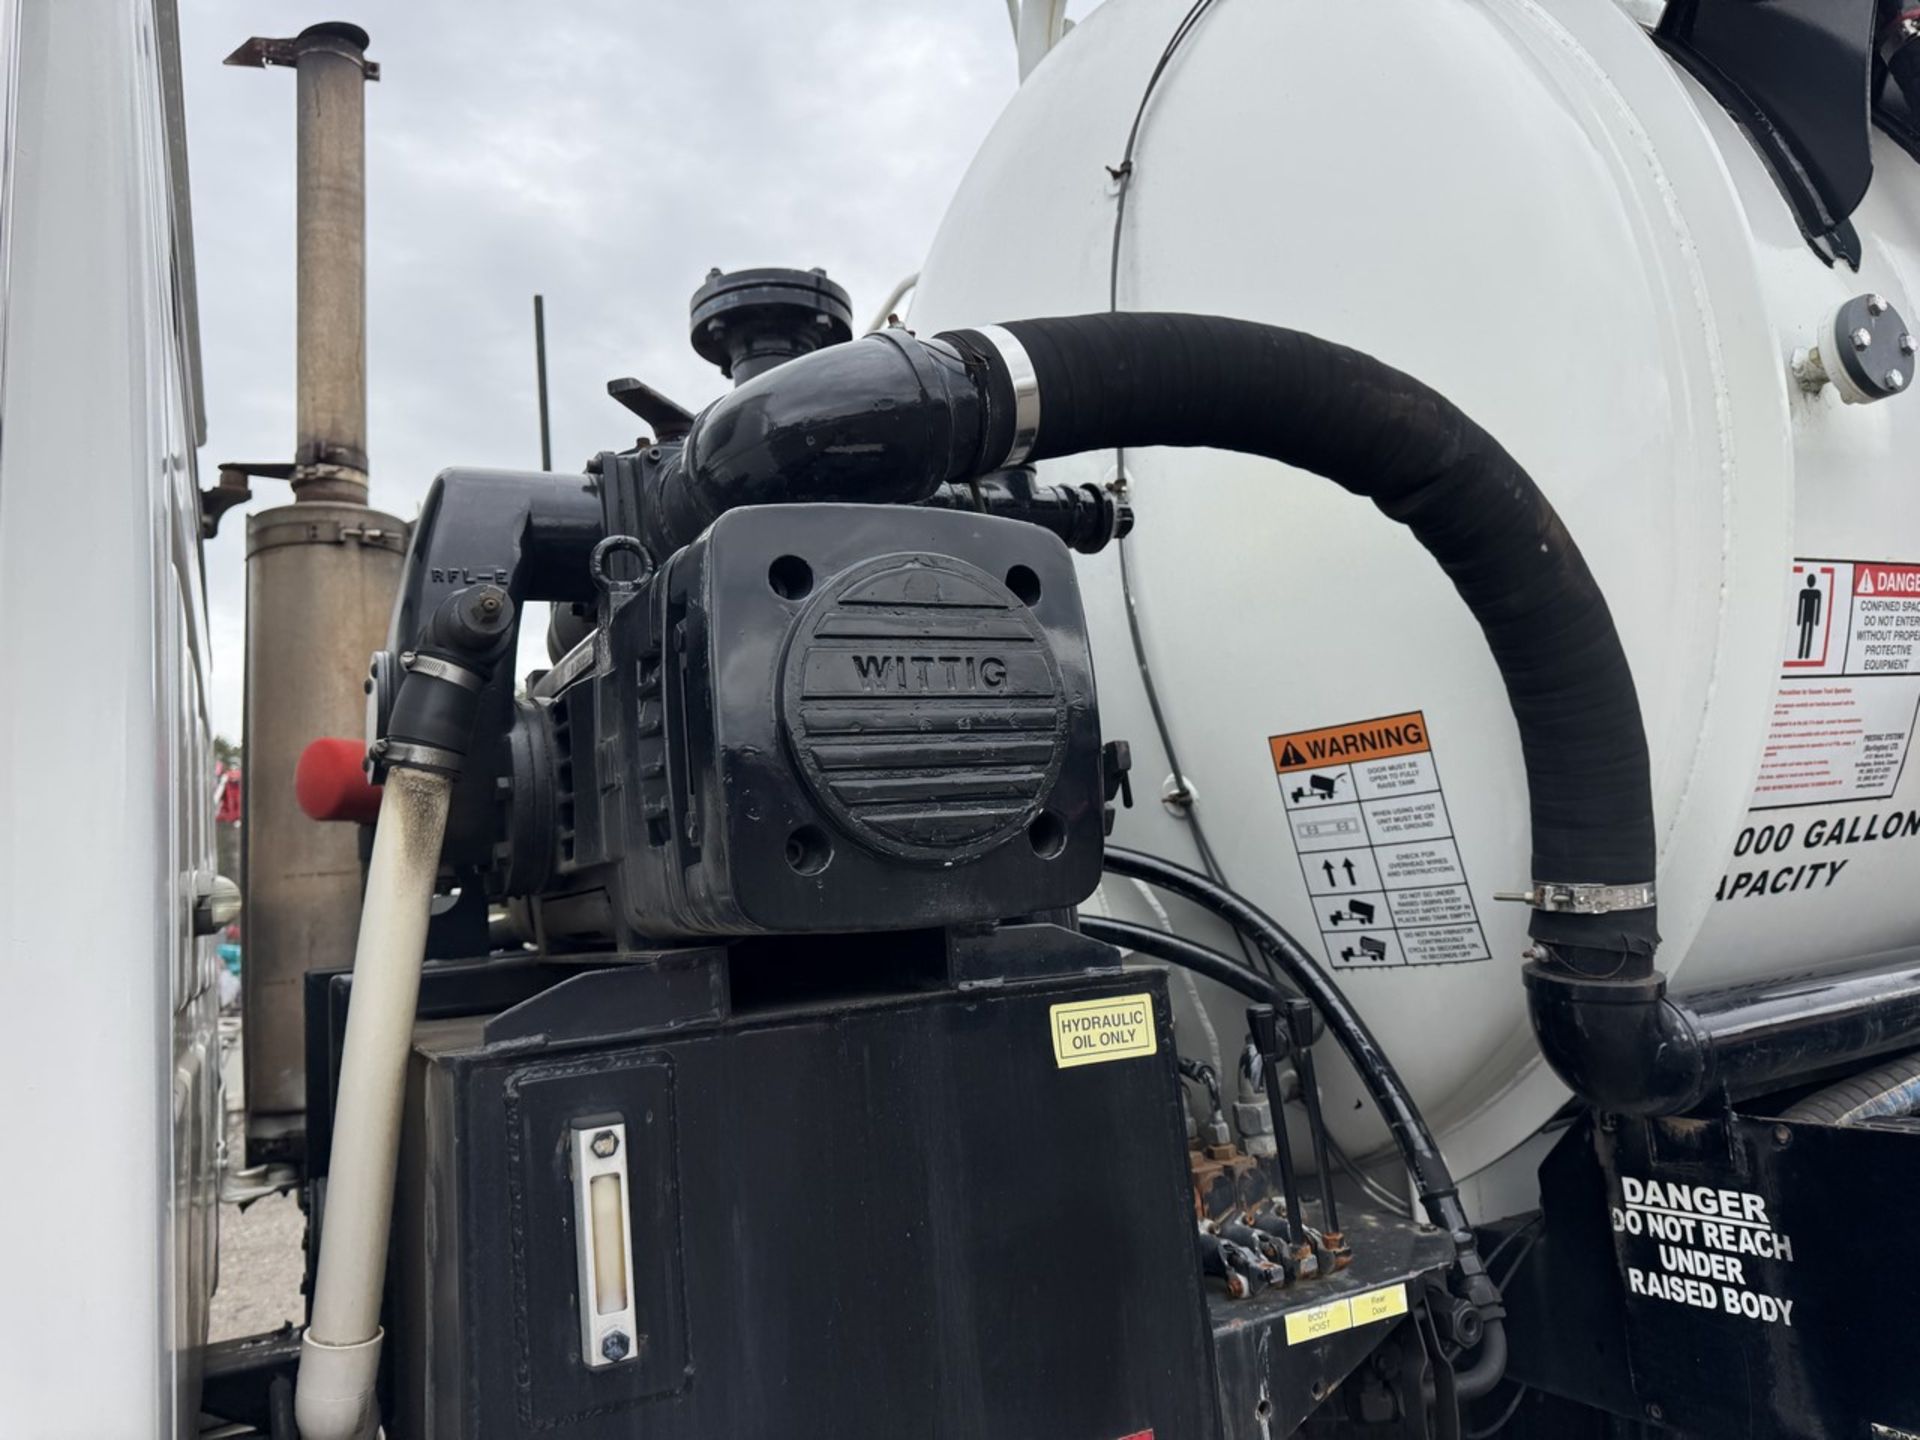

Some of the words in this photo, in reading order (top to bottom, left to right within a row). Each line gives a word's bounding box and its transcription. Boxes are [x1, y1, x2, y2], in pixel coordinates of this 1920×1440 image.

[431, 567, 509, 585] RFL-E
[1860, 600, 1900, 611] CONFINED
[1864, 616, 1876, 626] DO
[1878, 616, 1894, 626] NOT
[1857, 630, 1892, 640] WITHOUT
[1865, 645, 1912, 655] PROTECTIVE
[1864, 659, 1909, 670] EQUIPMENT
[852, 655, 1008, 690] WITTIG
[1306, 723, 1423, 760] WARNING
[1367, 766, 1386, 774] DOOR
[1388, 762, 1406, 772] MUST
[1408, 761, 1417, 769] BE
[1369, 774, 1388, 782] OPEN
[1399, 769, 1419, 778] FULLY
[1376, 781, 1396, 789] RAISE
[1372, 809, 1391, 817] WHEN
[1392, 806, 1414, 815] USING
[1415, 803, 1435, 812] HOIST
[1376, 817, 1392, 825] UNIT
[1393, 815, 1413, 823] MUST
[1424, 812, 1435, 820] ON
[1381, 824, 1402, 833] LEVEL
[1403, 820, 1434, 830] GROUND
[1396, 852, 1419, 860] CHECK
[1388, 860, 1424, 869] OVERHEAD
[1426, 857, 1448, 865] WIRES
[1402, 865, 1455, 876] OBSTRUCTIONS
[1061, 1010, 1143, 1033] HYDRAULIC
[1072, 1034, 1096, 1049] OIL
[1099, 1029, 1136, 1046] ONLY
[1621, 1176, 1770, 1223] DANGER
[1612, 1207, 1643, 1235] DO
[1646, 1212, 1695, 1244] NOT
[1702, 1221, 1794, 1262] REACH
[1659, 1244, 1746, 1285] UNDER
[1628, 1267, 1717, 1309] RAISED
[1722, 1286, 1793, 1326] BODY
[1308, 1311, 1328, 1322] BODY
[1371, 1306, 1387, 1316] Door
[1308, 1320, 1331, 1333] HOIST
